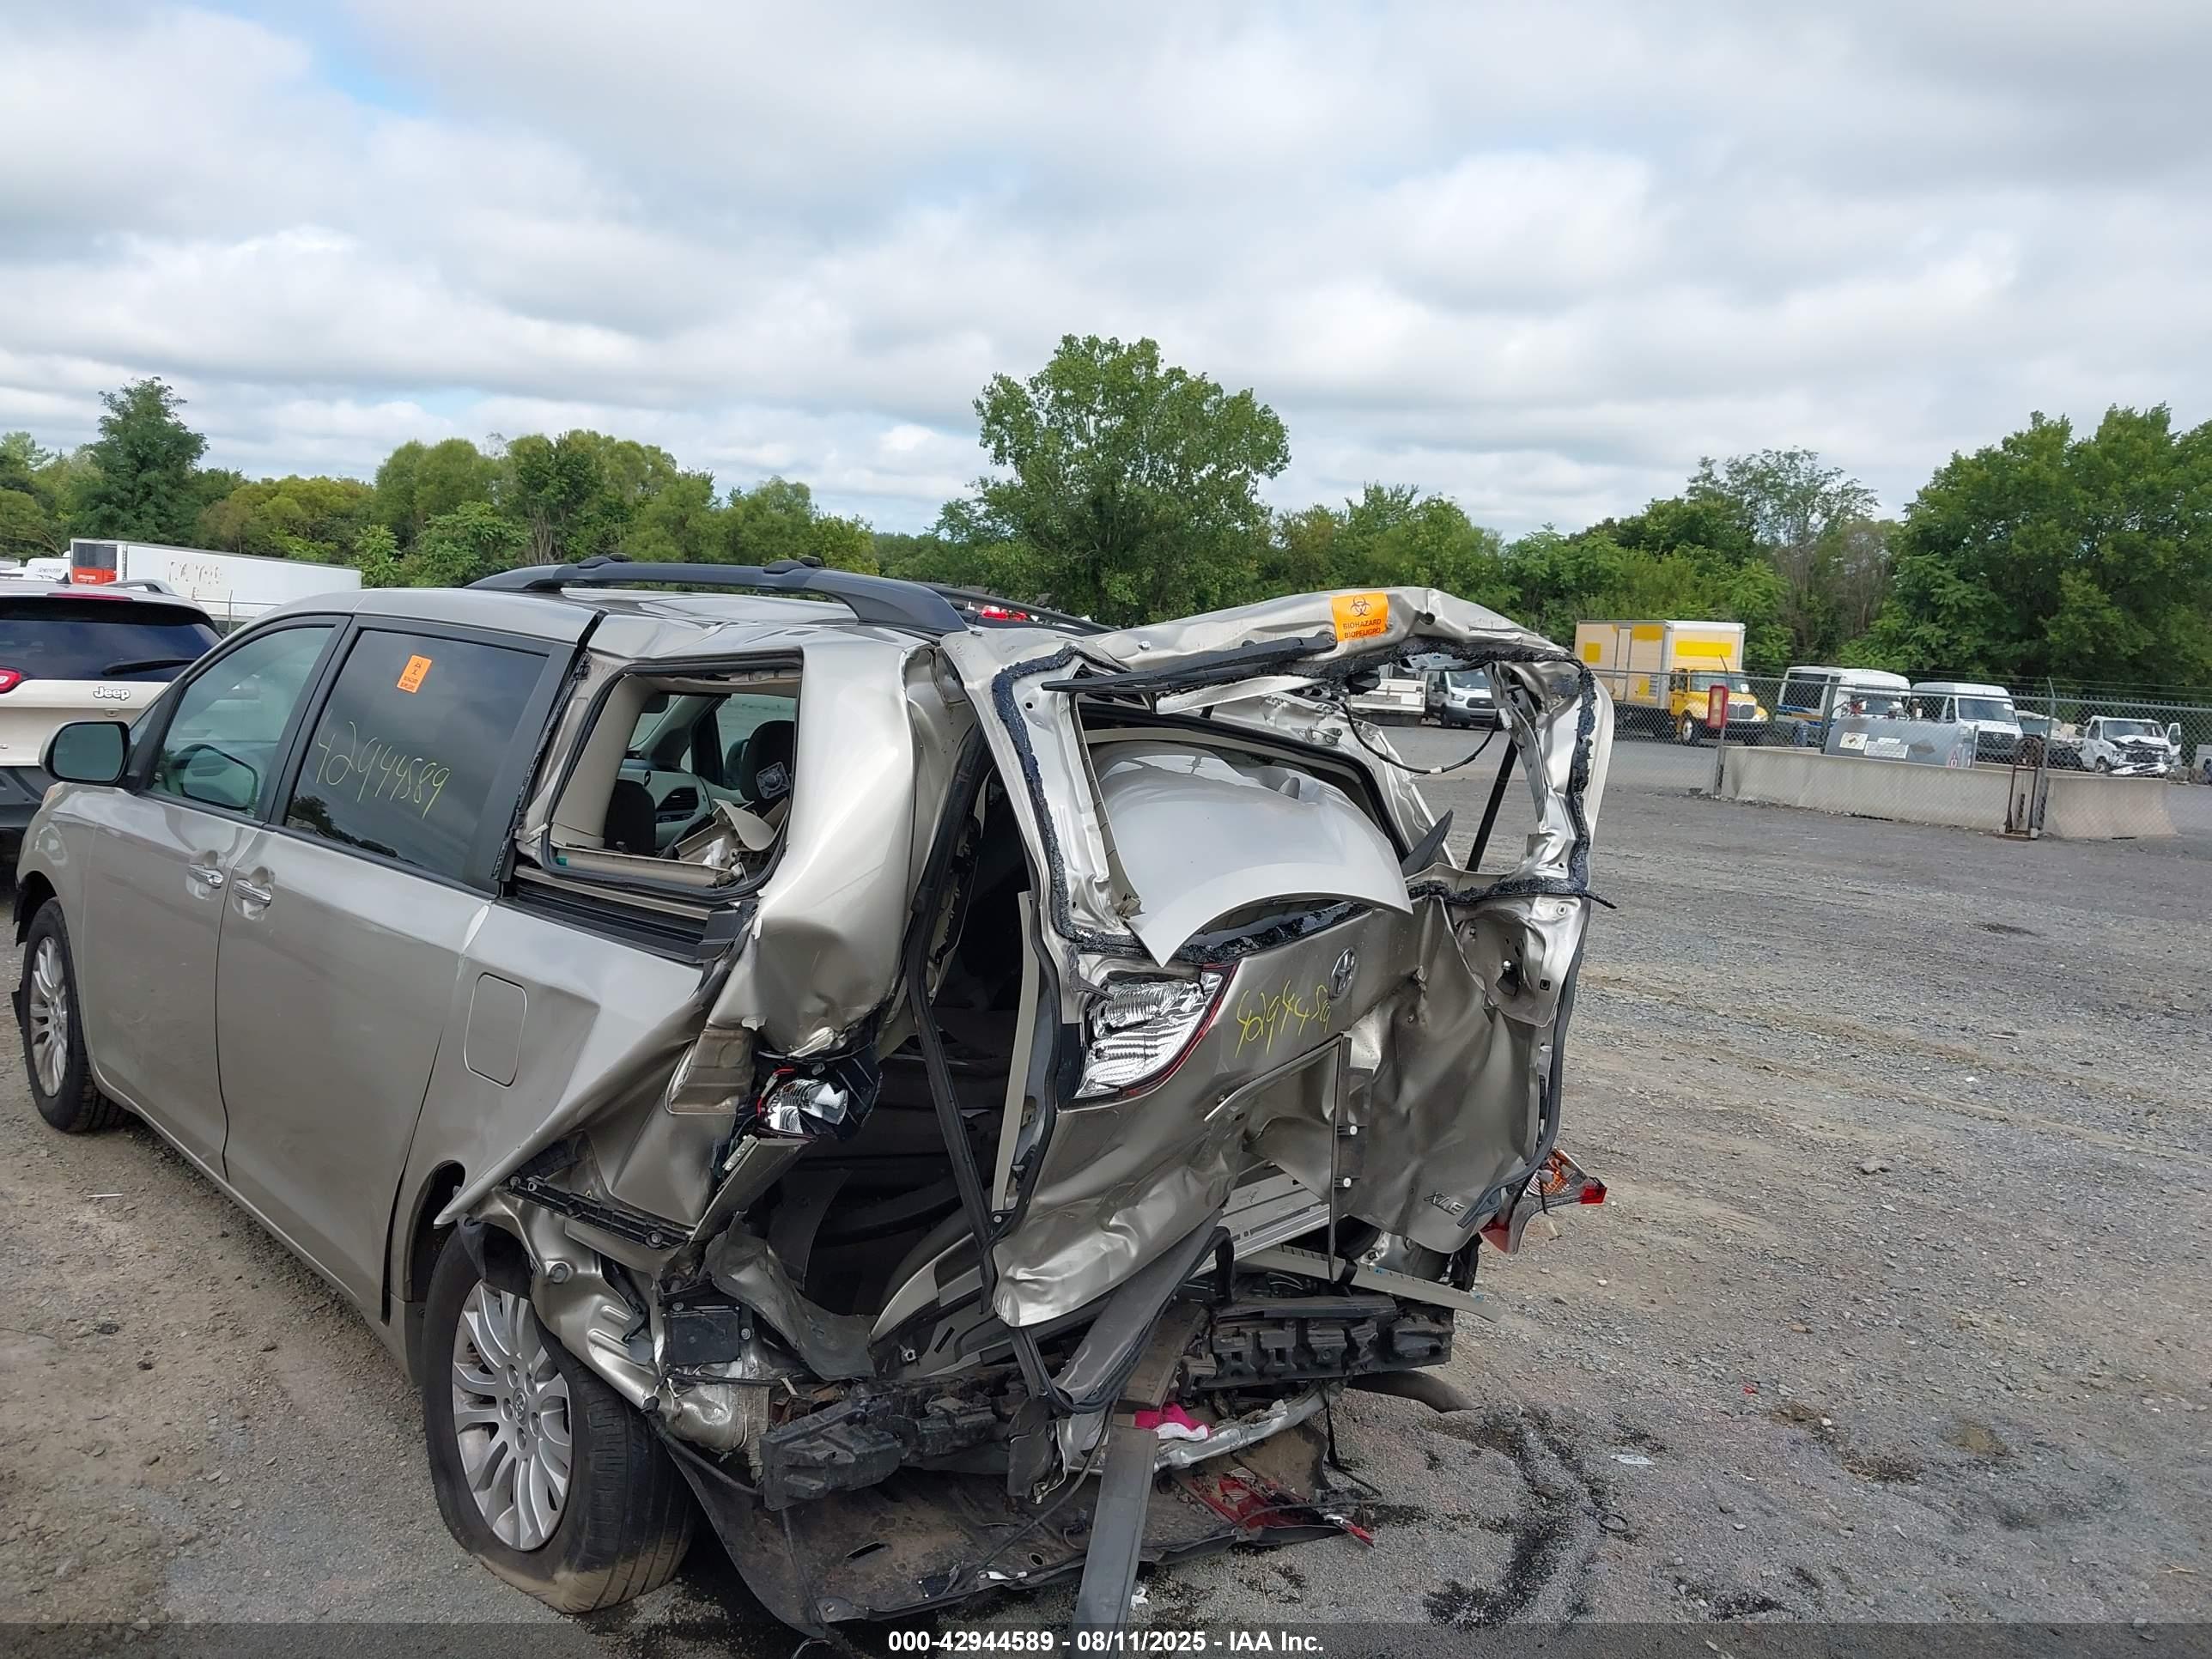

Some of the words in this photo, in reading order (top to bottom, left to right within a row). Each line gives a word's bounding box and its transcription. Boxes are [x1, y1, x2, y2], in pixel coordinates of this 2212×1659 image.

[1343, 618, 1382, 629] BIOHAZARD
[93, 686, 131, 701] Jeep
[316, 708, 450, 820] 42944589
[1423, 1191, 1465, 1216] XLE
